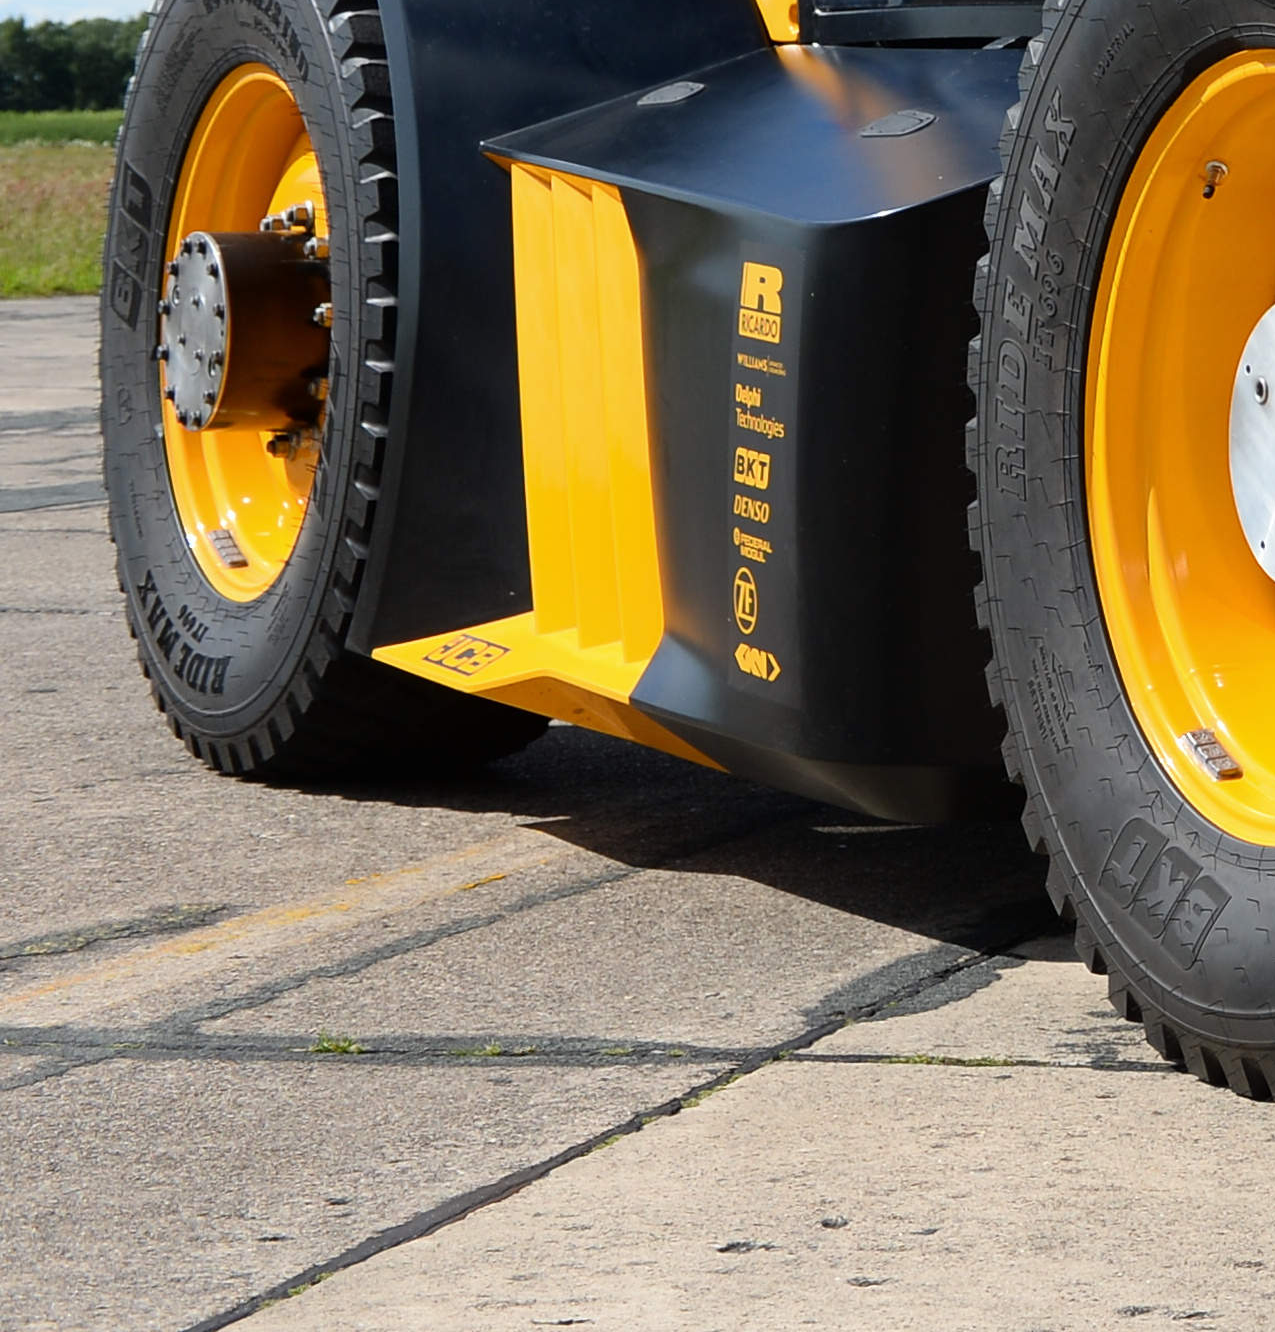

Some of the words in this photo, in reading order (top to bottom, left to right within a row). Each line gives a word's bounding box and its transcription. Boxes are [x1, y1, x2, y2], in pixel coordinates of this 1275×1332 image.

[111, 163, 153, 323] BKT
[741, 313, 779, 338] RICARDO
[735, 383, 761, 409] Delphi
[735, 407, 785, 439] Technologies
[736, 452, 769, 484] BKT
[734, 494, 770, 524] DENSO
[737, 578, 756, 622] ZF
[426, 635, 507, 672] JCB
